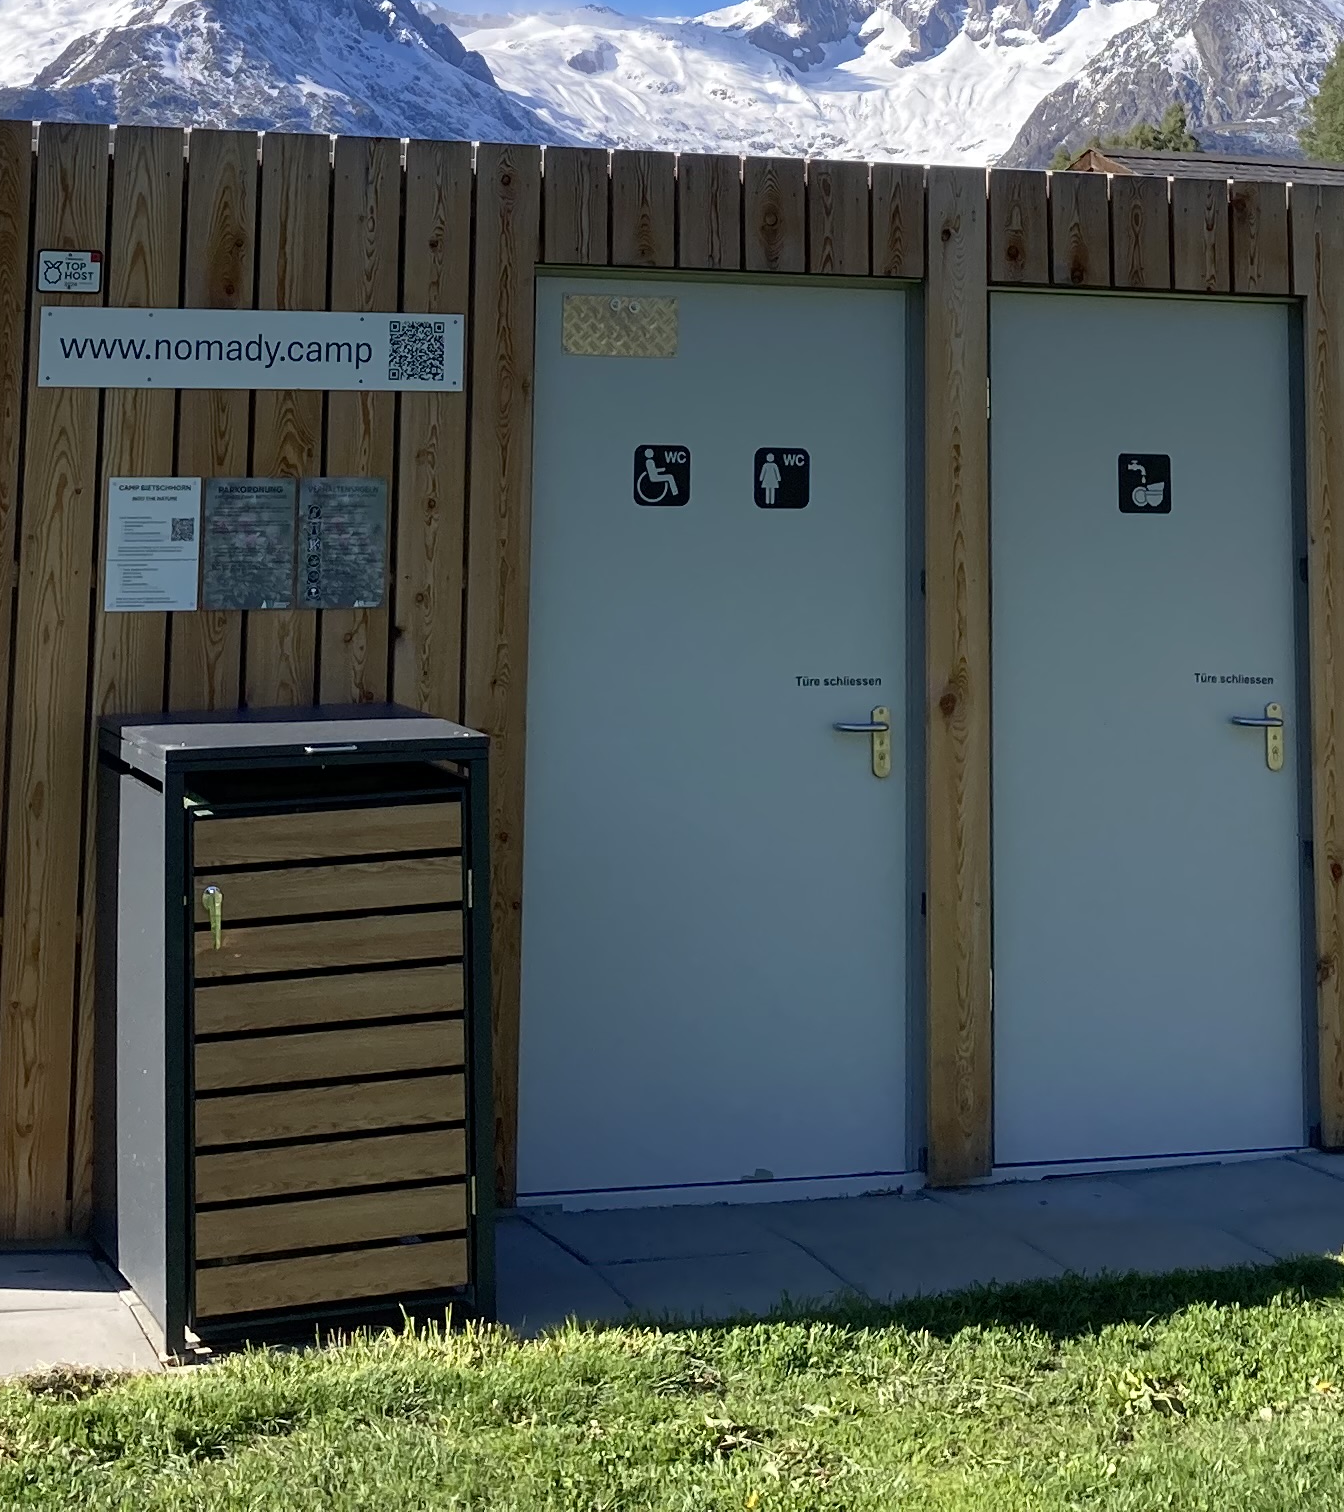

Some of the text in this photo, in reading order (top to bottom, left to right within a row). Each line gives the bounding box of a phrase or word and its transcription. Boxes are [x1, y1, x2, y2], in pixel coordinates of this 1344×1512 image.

[65, 262, 87, 271] TOP
[64, 271, 94, 280] HOST
[59, 333, 373, 370] www.nomady.camp
[664, 450, 687, 463] WC
[783, 453, 805, 466] WC
[795, 676, 882, 686] Türe schliessen
[1194, 673, 1274, 685] Türe schliessen
